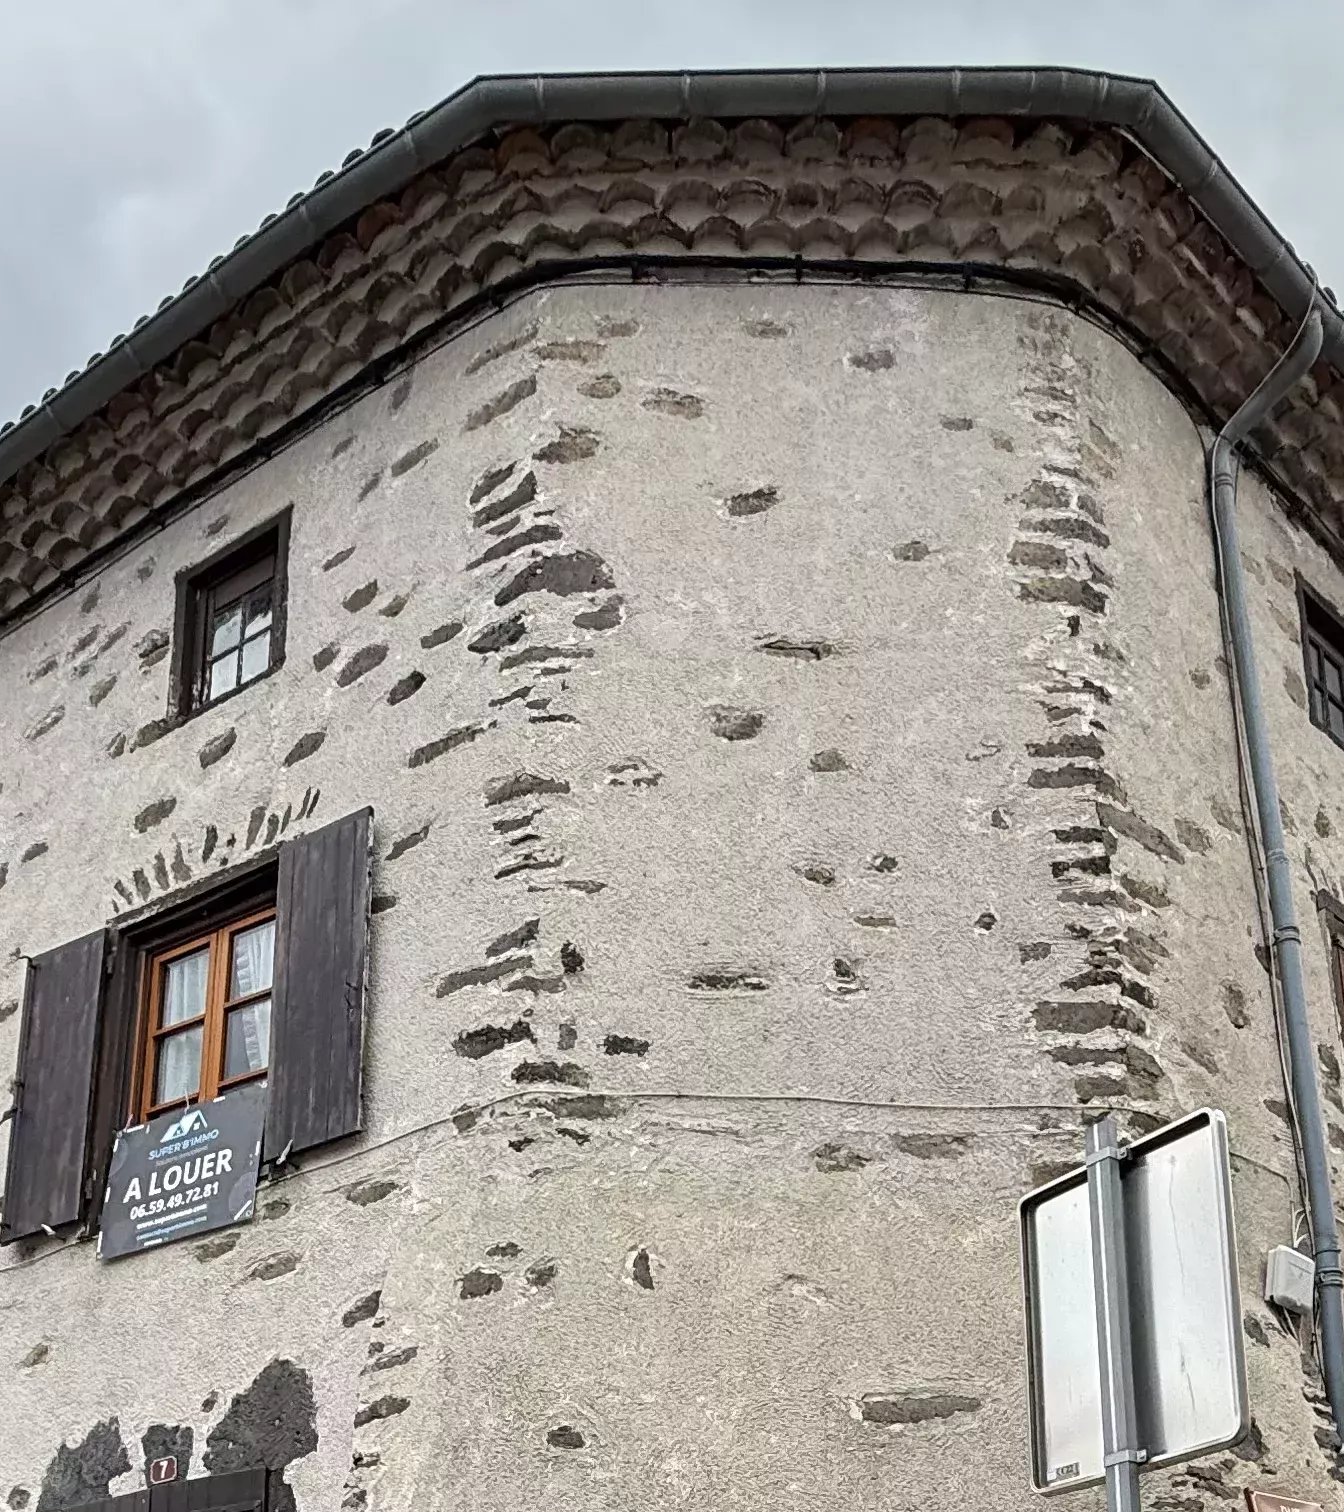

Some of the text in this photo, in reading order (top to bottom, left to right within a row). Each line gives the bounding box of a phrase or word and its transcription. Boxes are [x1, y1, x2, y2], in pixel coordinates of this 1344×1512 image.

[123, 1177, 142, 1203] A
[148, 1148, 233, 1197] LOUER
[129, 1181, 219, 1220] 06.59.49.72.81
